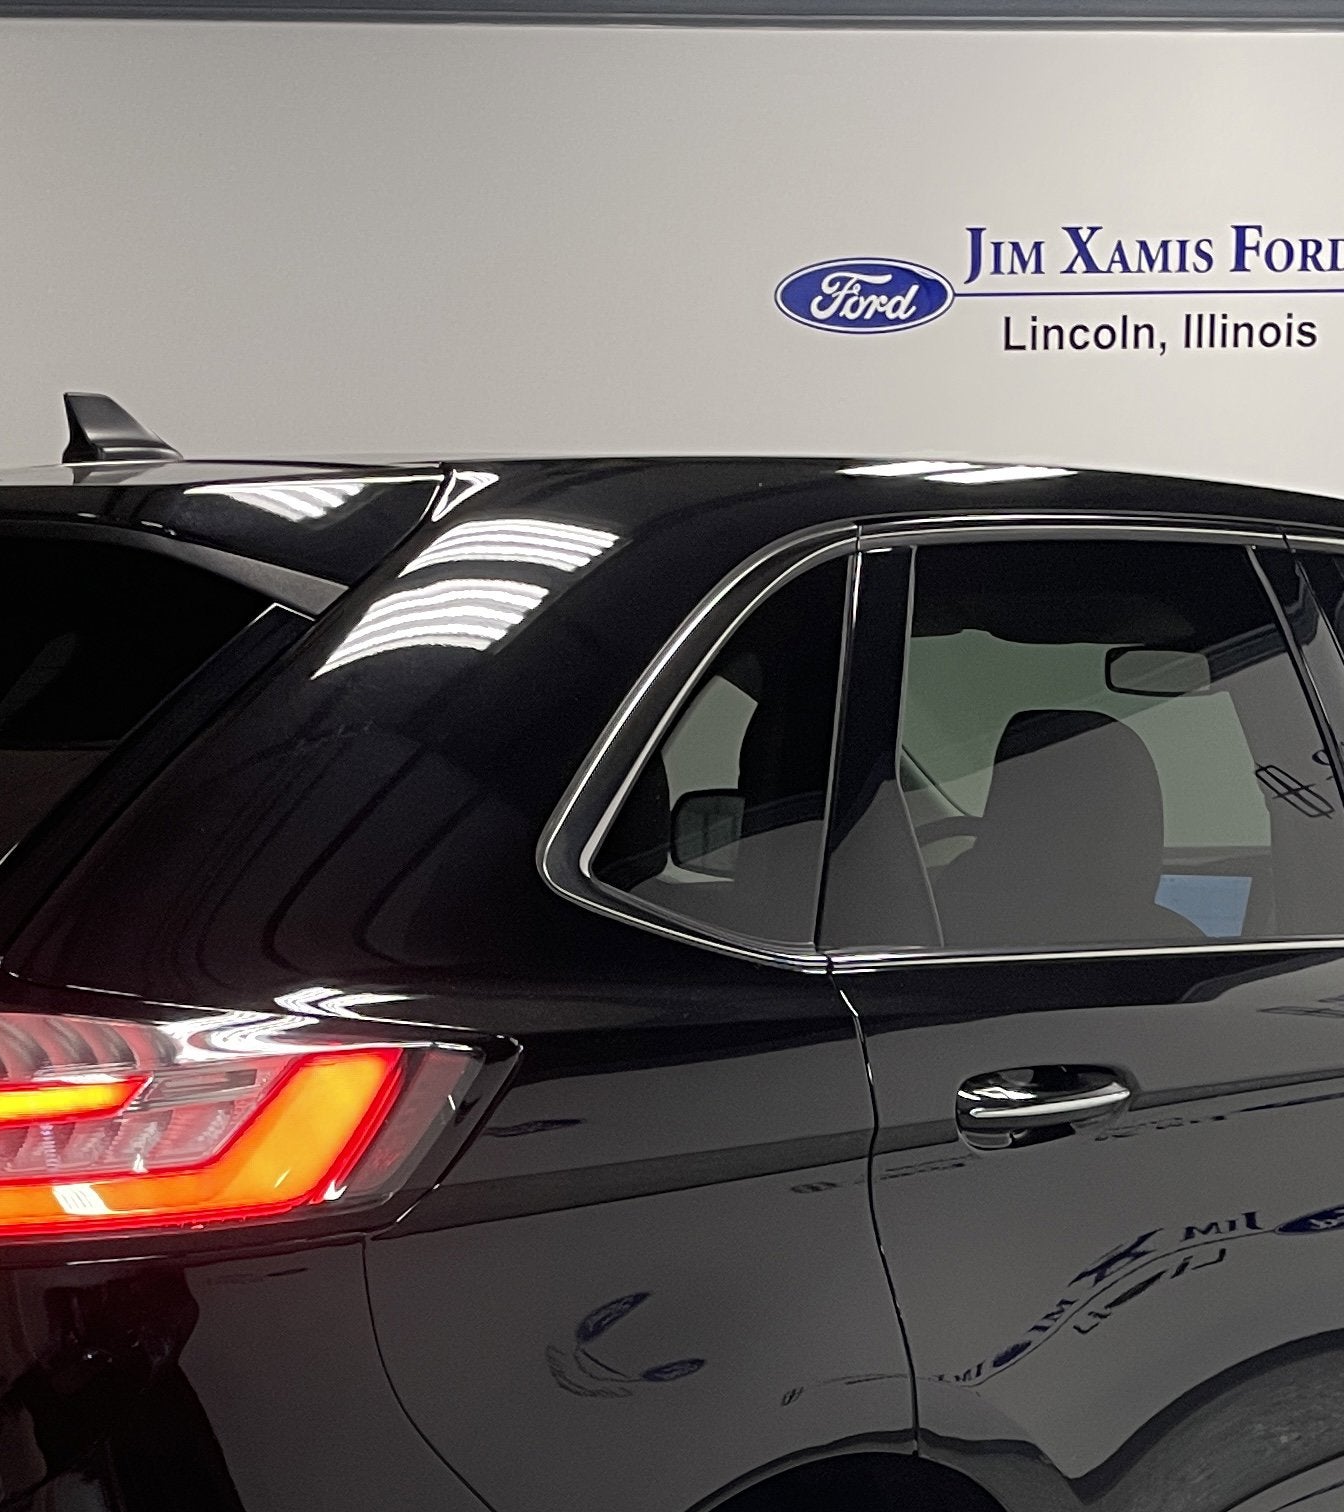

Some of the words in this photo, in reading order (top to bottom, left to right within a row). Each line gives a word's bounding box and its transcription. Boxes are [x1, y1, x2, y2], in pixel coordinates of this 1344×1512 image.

[964, 227, 1045, 285] JIM
[1060, 226, 1213, 274] XAMIS
[809, 271, 918, 321] Ford
[1003, 315, 1167, 356] Lincoln,
[1184, 313, 1318, 350] Illinois
